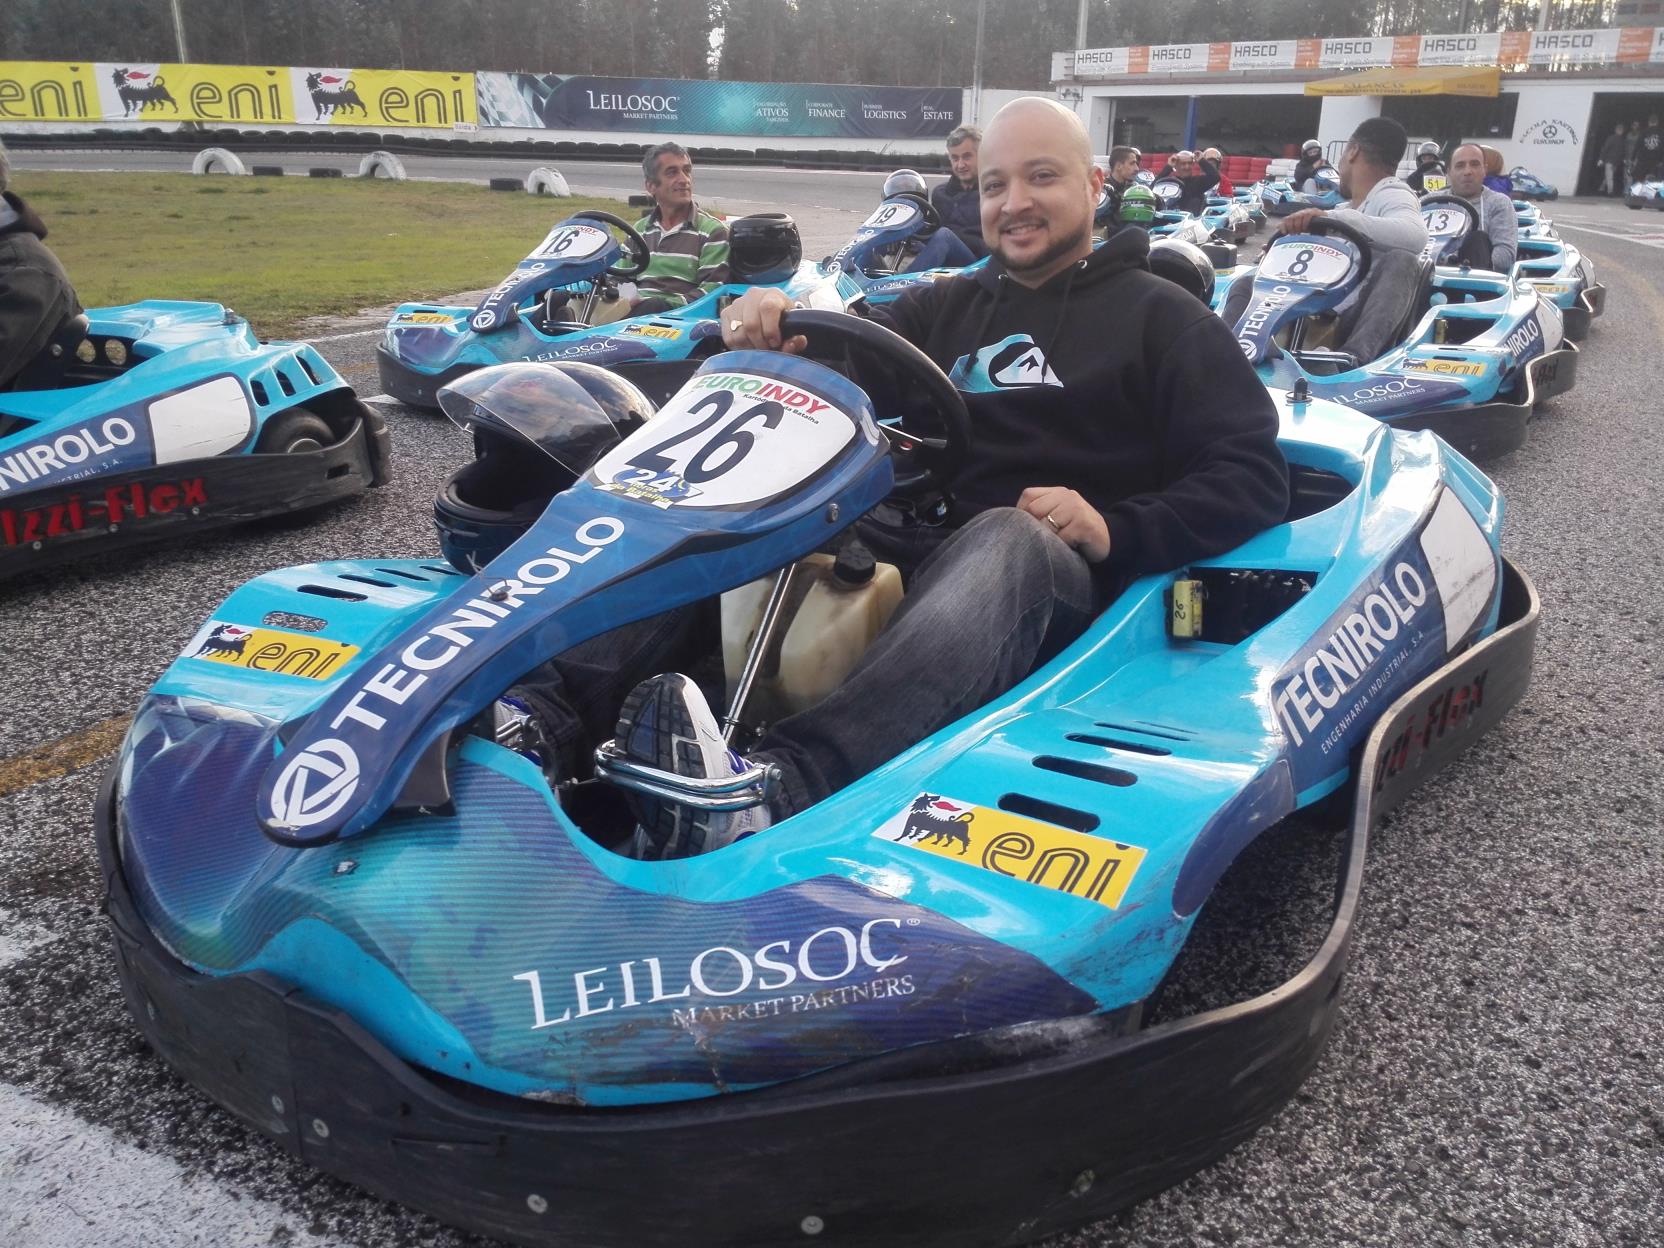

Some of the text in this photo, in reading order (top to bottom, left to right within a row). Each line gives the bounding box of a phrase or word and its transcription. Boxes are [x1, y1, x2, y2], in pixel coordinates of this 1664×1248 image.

[1234, 44, 1277, 58] HASCO
[1324, 41, 1372, 55] HASCO
[1424, 38, 1477, 52] HASCO
[1536, 33, 1594, 49] HASCO
[1077, 51, 1113, 64] HASCO
[1152, 48, 1192, 61] HASCO
[0, 66, 88, 118] eni
[190, 70, 282, 120] eni
[379, 75, 465, 124] eni
[756, 107, 789, 117] ATIVOS
[808, 108, 846, 118] FINANCE
[864, 110, 907, 119] LOGISTICS
[923, 111, 954, 120] ESTATE
[873, 207, 898, 224] 19
[1423, 212, 1450, 231] 13
[542, 230, 580, 255] 16
[1281, 243, 1343, 257] EUROINDY
[1287, 249, 1314, 276] 8
[645, 328, 681, 341] eni
[522, 338, 617, 362] LEILOSOC
[1433, 361, 1482, 376] eni
[692, 376, 831, 414] EUROINDY
[1355, 387, 1426, 405] MARKET PARTNERS
[624, 389, 785, 484] 26
[623, 468, 681, 492] 24
[1174, 599, 1186, 620] 26
[329, 516, 626, 731] TECNIROLO
[246, 642, 350, 678] eni
[1275, 561, 1427, 748] TECNIROLO
[1320, 695, 1370, 755] ENGENHARIA
[981, 832, 1131, 902] eni
[672, 974, 916, 1027] MARKET PARTNERS
